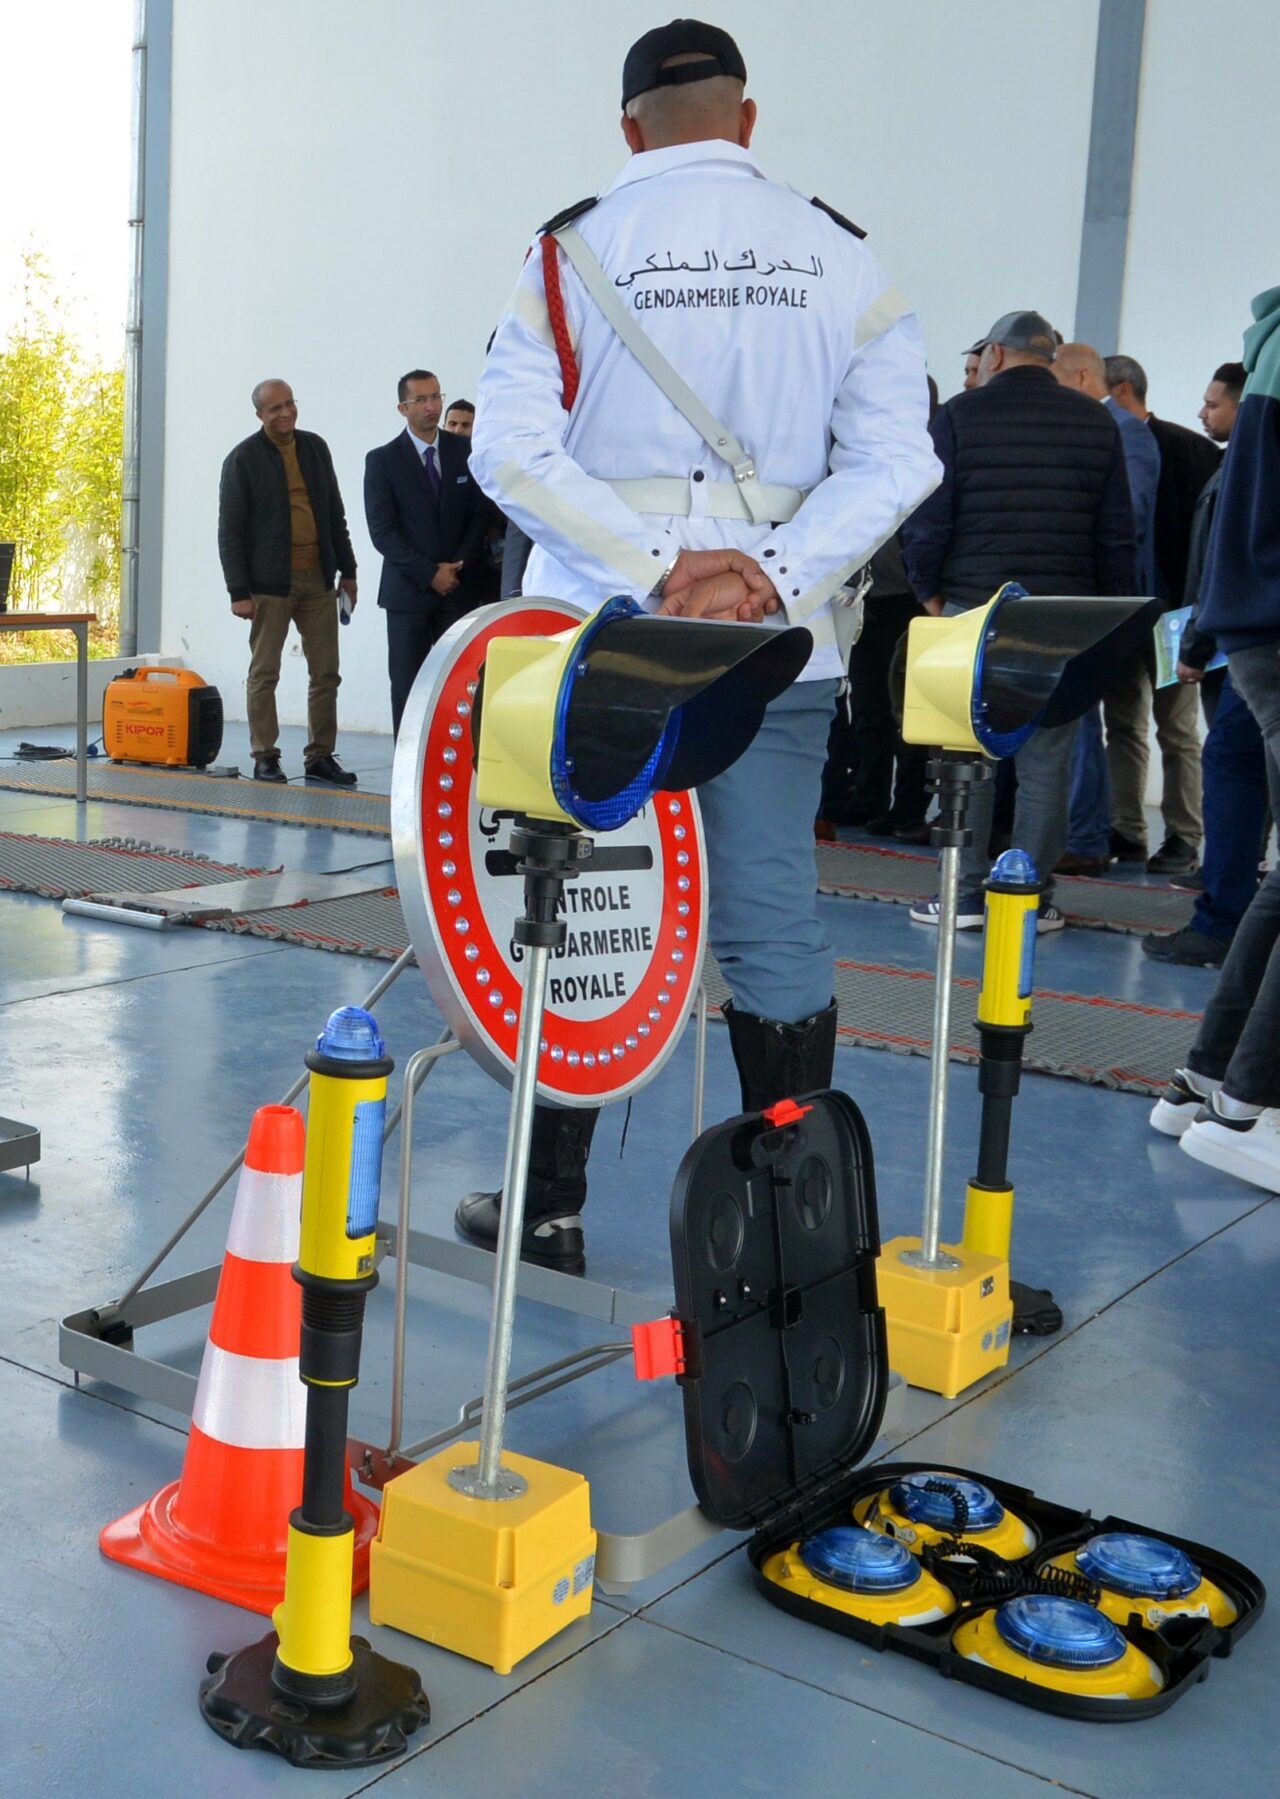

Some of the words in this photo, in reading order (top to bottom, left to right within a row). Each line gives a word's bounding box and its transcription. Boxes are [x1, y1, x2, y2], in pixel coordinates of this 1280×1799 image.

[615, 249, 719, 290] الملكي
[723, 248, 824, 278] الدرك
[634, 287, 740, 310] GENDARMERIE
[745, 286, 808, 308] ROYALE
[125, 724, 165, 737] KIPOR
[524, 885, 631, 914] NTROLE
[509, 926, 653, 963] GDARMERIE
[550, 971, 626, 1005] ROYALE
